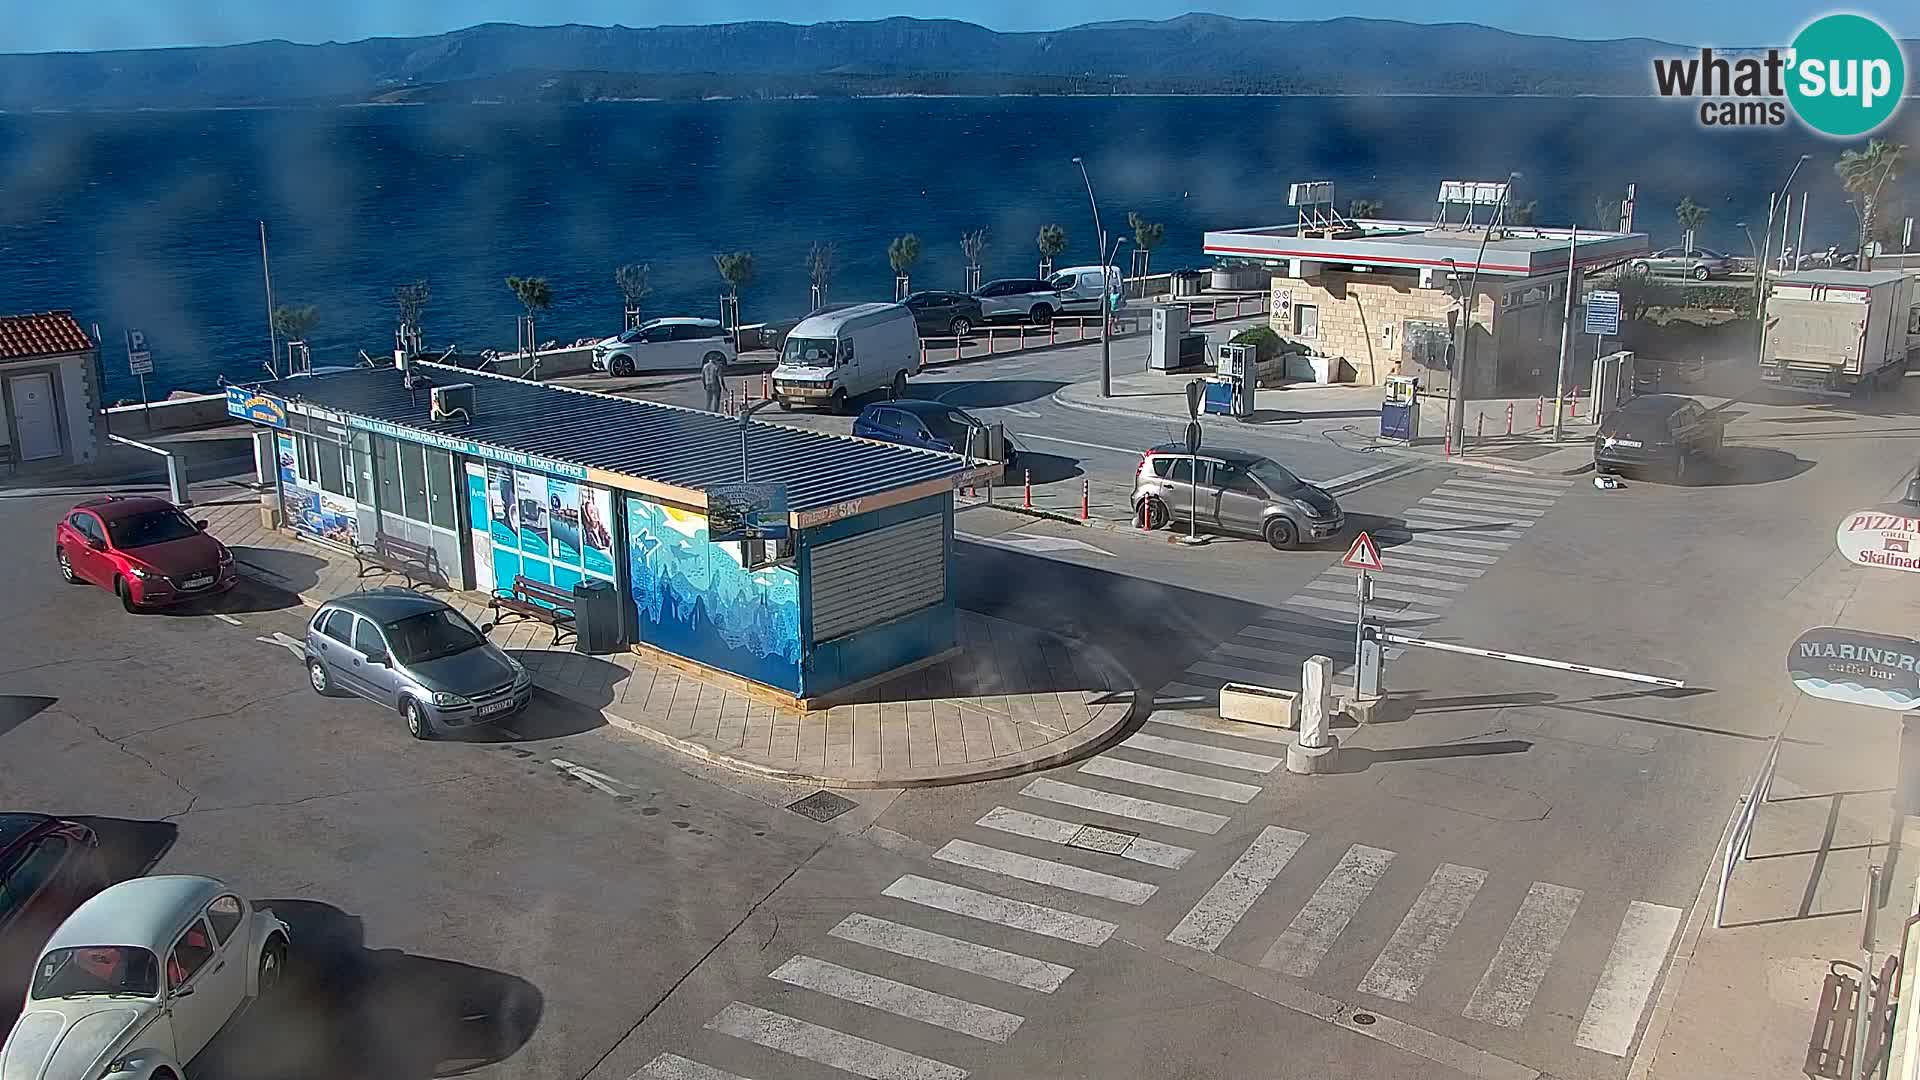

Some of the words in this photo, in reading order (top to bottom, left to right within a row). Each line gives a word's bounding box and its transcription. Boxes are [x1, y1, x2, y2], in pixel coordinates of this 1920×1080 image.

[437, 436, 469, 452] POSTAJA
[480, 446, 494, 458] BUS
[495, 449, 527, 465] STATION
[529, 455, 555, 471] TICKET
[555, 461, 583, 478] OFFICE
[1870, 666, 1896, 680] bar
